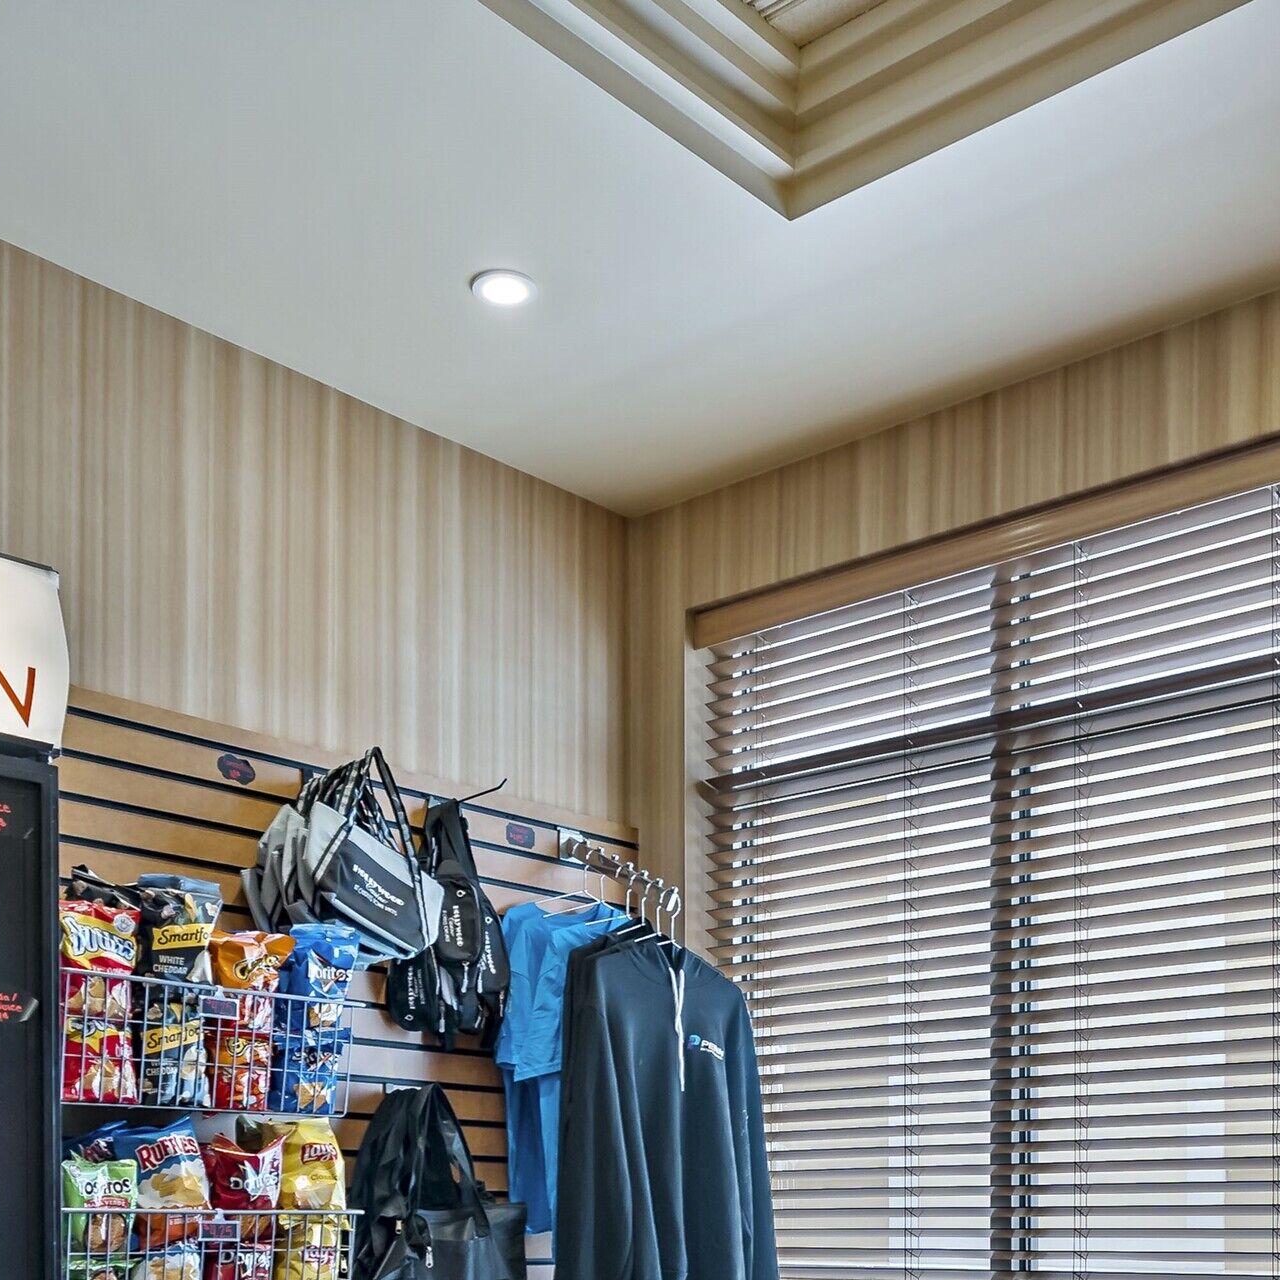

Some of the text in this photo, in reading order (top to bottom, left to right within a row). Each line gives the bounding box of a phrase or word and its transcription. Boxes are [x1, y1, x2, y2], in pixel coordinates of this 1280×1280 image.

[158, 954, 186, 966] WHITE
[152, 964, 189, 975] CHEDDAR
[134, 1135, 201, 1174] RUFFLES
